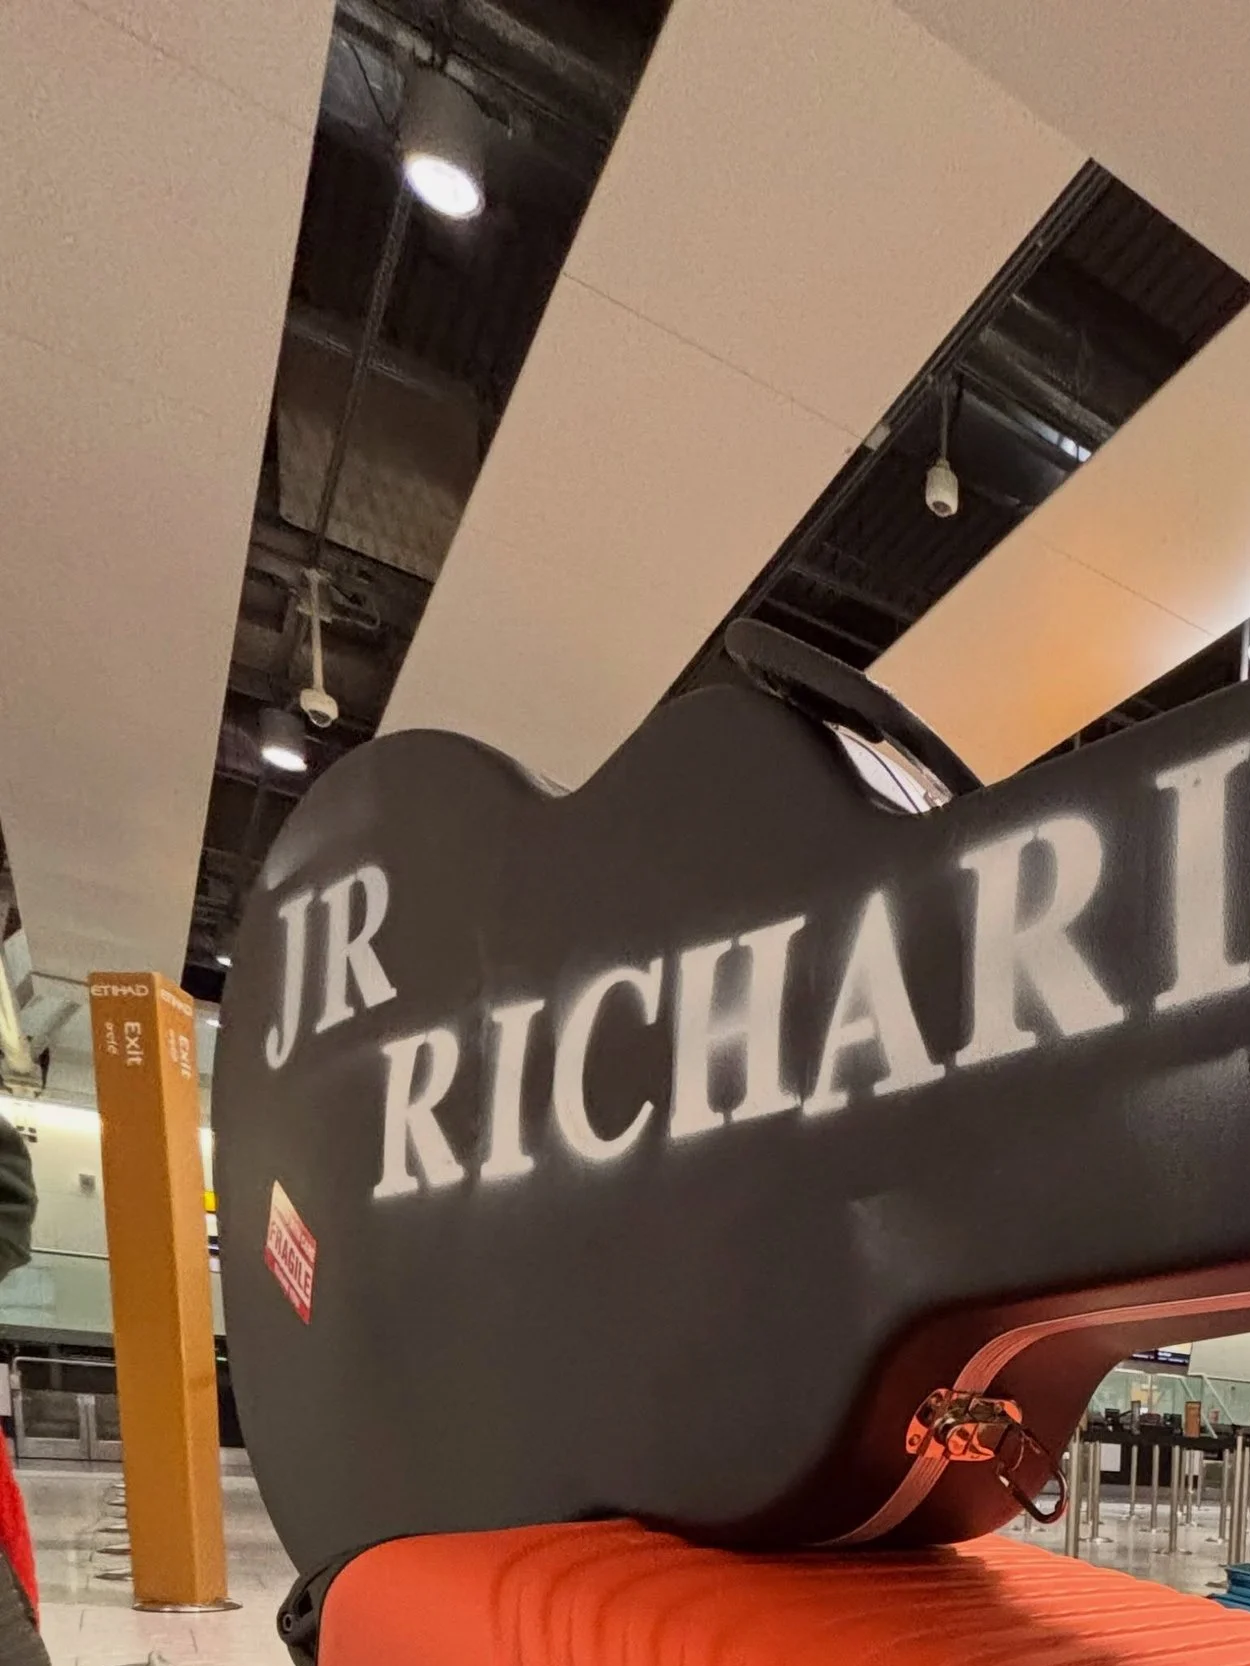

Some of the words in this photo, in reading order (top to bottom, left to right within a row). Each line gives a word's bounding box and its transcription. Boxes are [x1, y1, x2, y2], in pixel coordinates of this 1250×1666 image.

[90, 984, 149, 997] ETIHAD
[264, 864, 397, 1070] JR
[269, 1219, 312, 1299] FRAGILE
